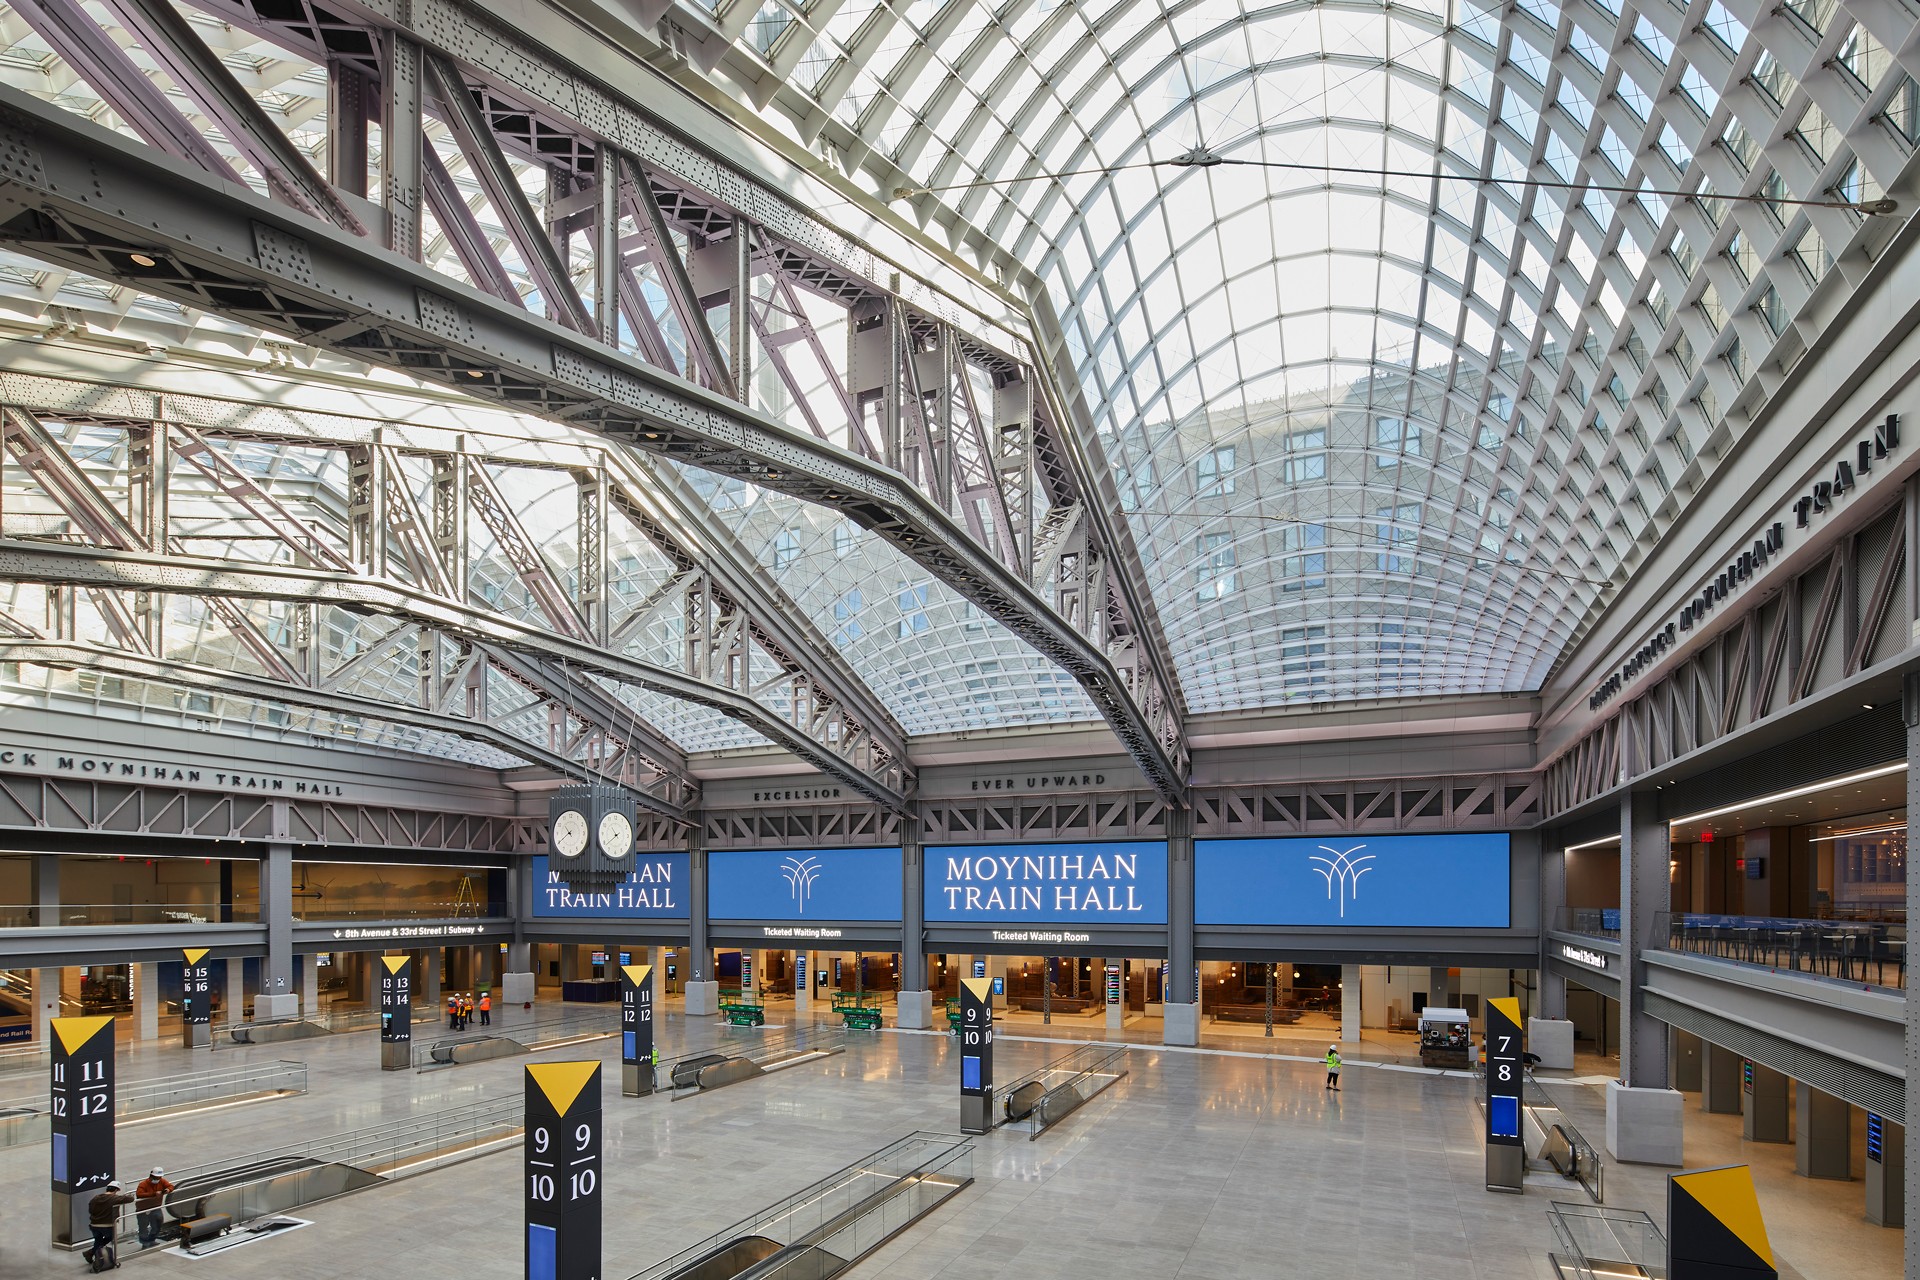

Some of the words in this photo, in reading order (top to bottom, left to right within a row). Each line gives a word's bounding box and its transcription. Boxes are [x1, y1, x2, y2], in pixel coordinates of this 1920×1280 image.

[1680, 522, 1783, 632] MOYNIHAN
[1793, 413, 1899, 529] TRAIN
[58, 757, 200, 782] MOYNIHAN
[216, 773, 283, 790] TRAIN
[296, 782, 343, 796] HALL
[971, 779, 1014, 791] EVER
[1027, 775, 1105, 788] UPWARD
[754, 789, 840, 801] EXCELSIOR
[946, 854, 1137, 881] MOYNIHAN
[546, 888, 610, 908] TRAIN
[618, 888, 676, 908] HALL
[944, 886, 1042, 910] TRAIN
[1054, 886, 1143, 911] HALL
[345, 929, 359, 938] 8th
[361, 929, 390, 937] Avenue
[392, 928, 399, 936] &
[400, 927, 418, 936] 33rd
[419, 926, 442, 935] Street
[449, 925, 475, 935] Subway
[764, 927, 792, 937] Ticketed
[794, 928, 820, 938] Waiting
[821, 928, 842, 937] Room
[993, 931, 1028, 941] Ticketed
[1030, 932, 1062, 943] Waiting
[1064, 932, 1090, 942] Room
[184, 968, 191, 977] 15
[196, 968, 207, 977] 15
[184, 983, 191, 992] 16
[196, 982, 208, 992] 16
[383, 978, 391, 988] 13
[397, 977, 408, 988] 13
[383, 995, 391, 1005] 14
[397, 994, 408, 1005] 14
[625, 991, 633, 1002] 11
[641, 990, 650, 1002] 11
[625, 1010, 635, 1022] 12
[641, 1009, 650, 1021] 12
[967, 1008, 976, 1022] 9
[986, 1007, 991, 1021] 9
[965, 1031, 979, 1045] 10
[985, 1030, 992, 1044] 10
[1498, 1036, 1511, 1052] 7
[54, 1063, 64, 1082] 11
[81, 1060, 105, 1081] 11
[1498, 1064, 1511, 1081] 8
[53, 1096, 66, 1117] 12
[80, 1093, 107, 1116] 12
[534, 1127, 549, 1153] 9
[575, 1124, 591, 1151] 9
[531, 1174, 554, 1201] 10
[570, 1169, 596, 1200] 10
